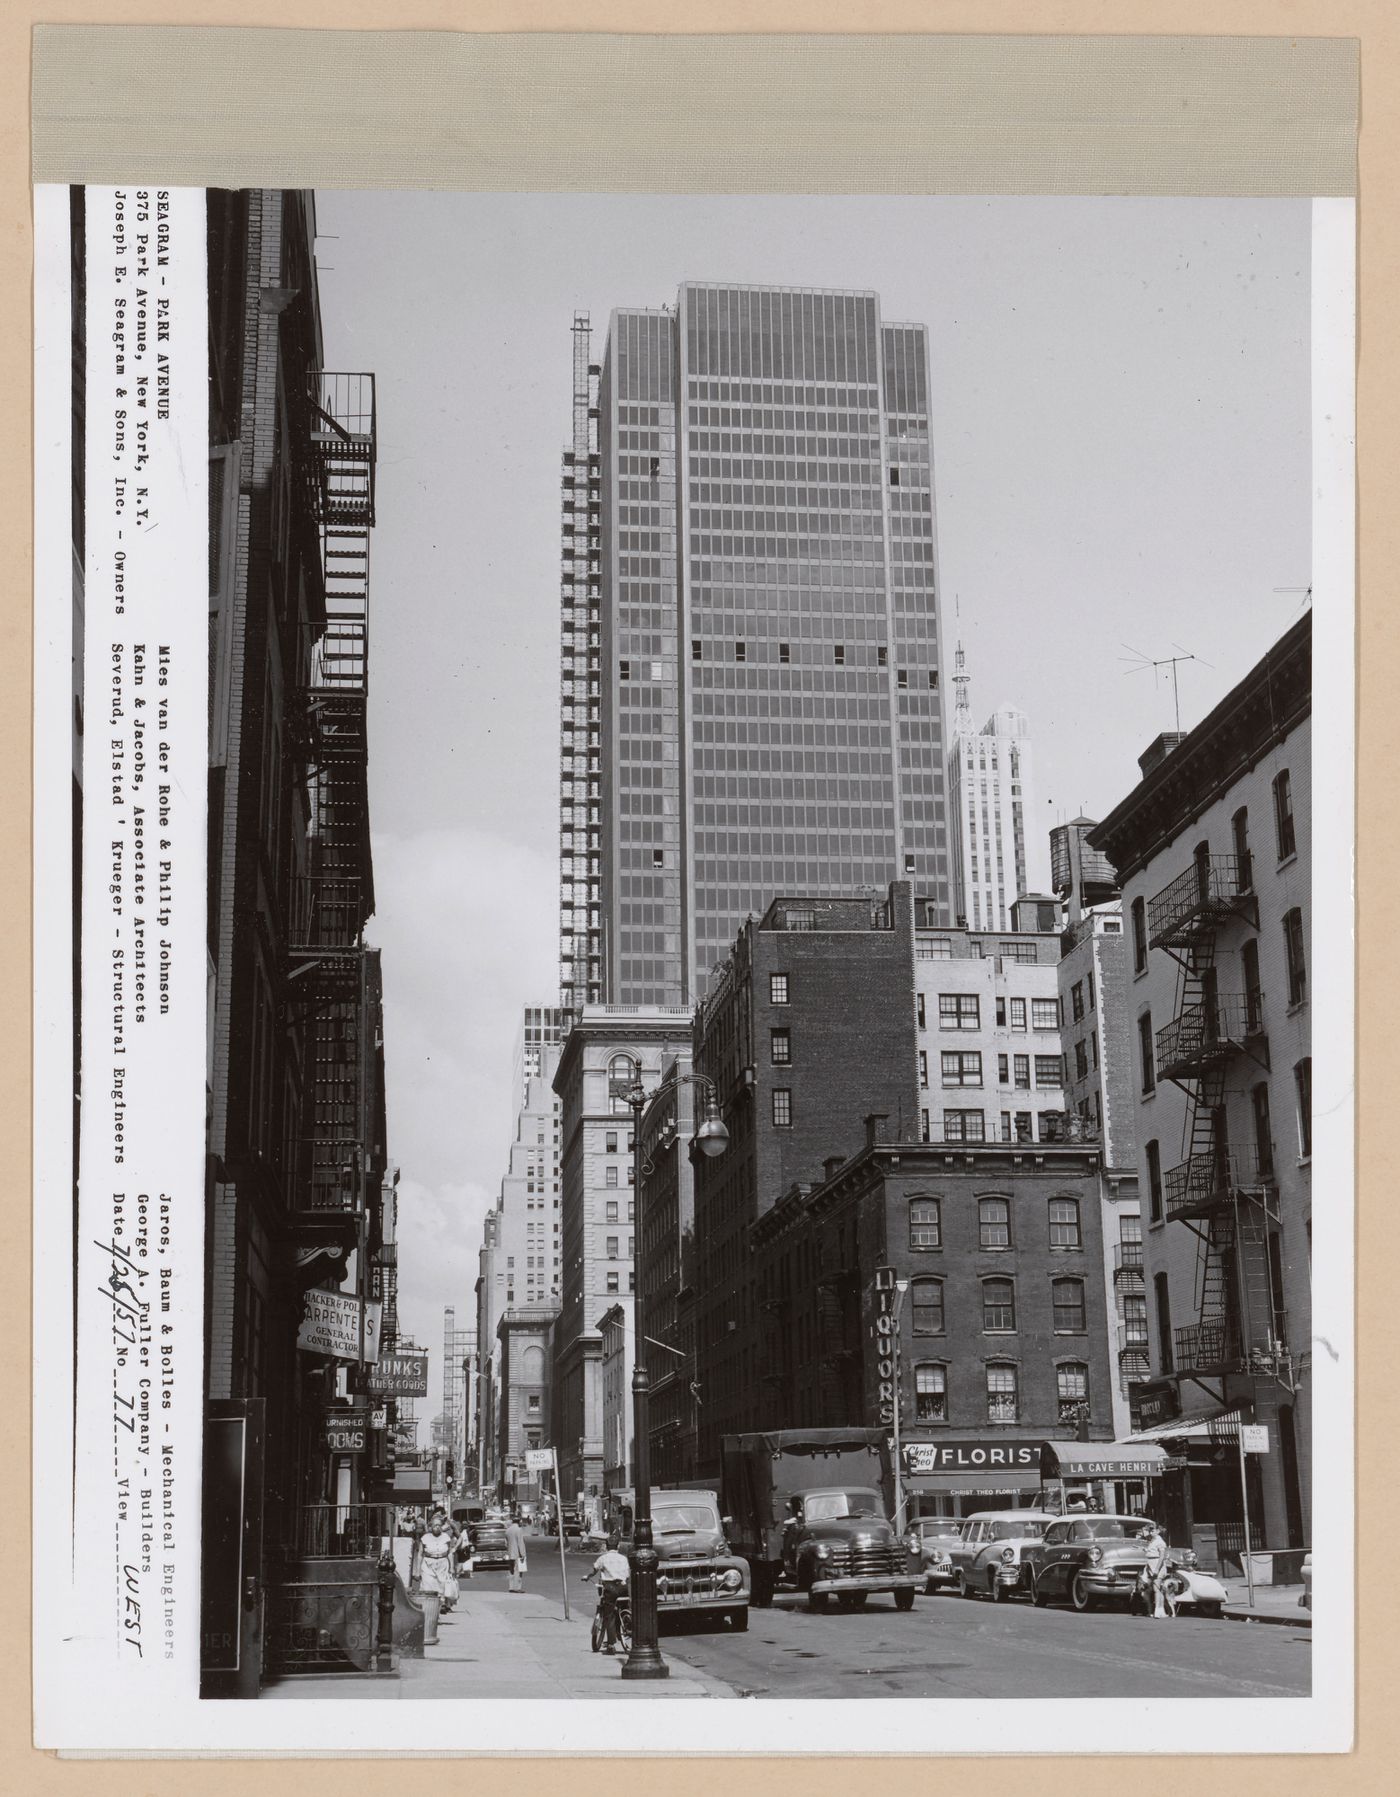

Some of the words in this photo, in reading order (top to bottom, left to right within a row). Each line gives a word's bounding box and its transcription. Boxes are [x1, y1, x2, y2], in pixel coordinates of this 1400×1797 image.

[304, 1305, 374, 1336] ARPENTES
[315, 1326, 355, 1341] GENERAL
[875, 1270, 894, 1424] LIQUORS
[364, 1360, 422, 1376] RUNKS
[395, 1379, 426, 1391] GOODS
[326, 1418, 364, 1427] URNISHED
[1249, 1428, 1261, 1436] NO
[321, 1431, 364, 1449] OOMS
[908, 1445, 934, 1457] Christ
[941, 1447, 1041, 1465] FLORIST
[1070, 1463, 1084, 1473] LA
[1088, 1463, 1114, 1473] CAVE
[1120, 1462, 1151, 1472] HENRI
